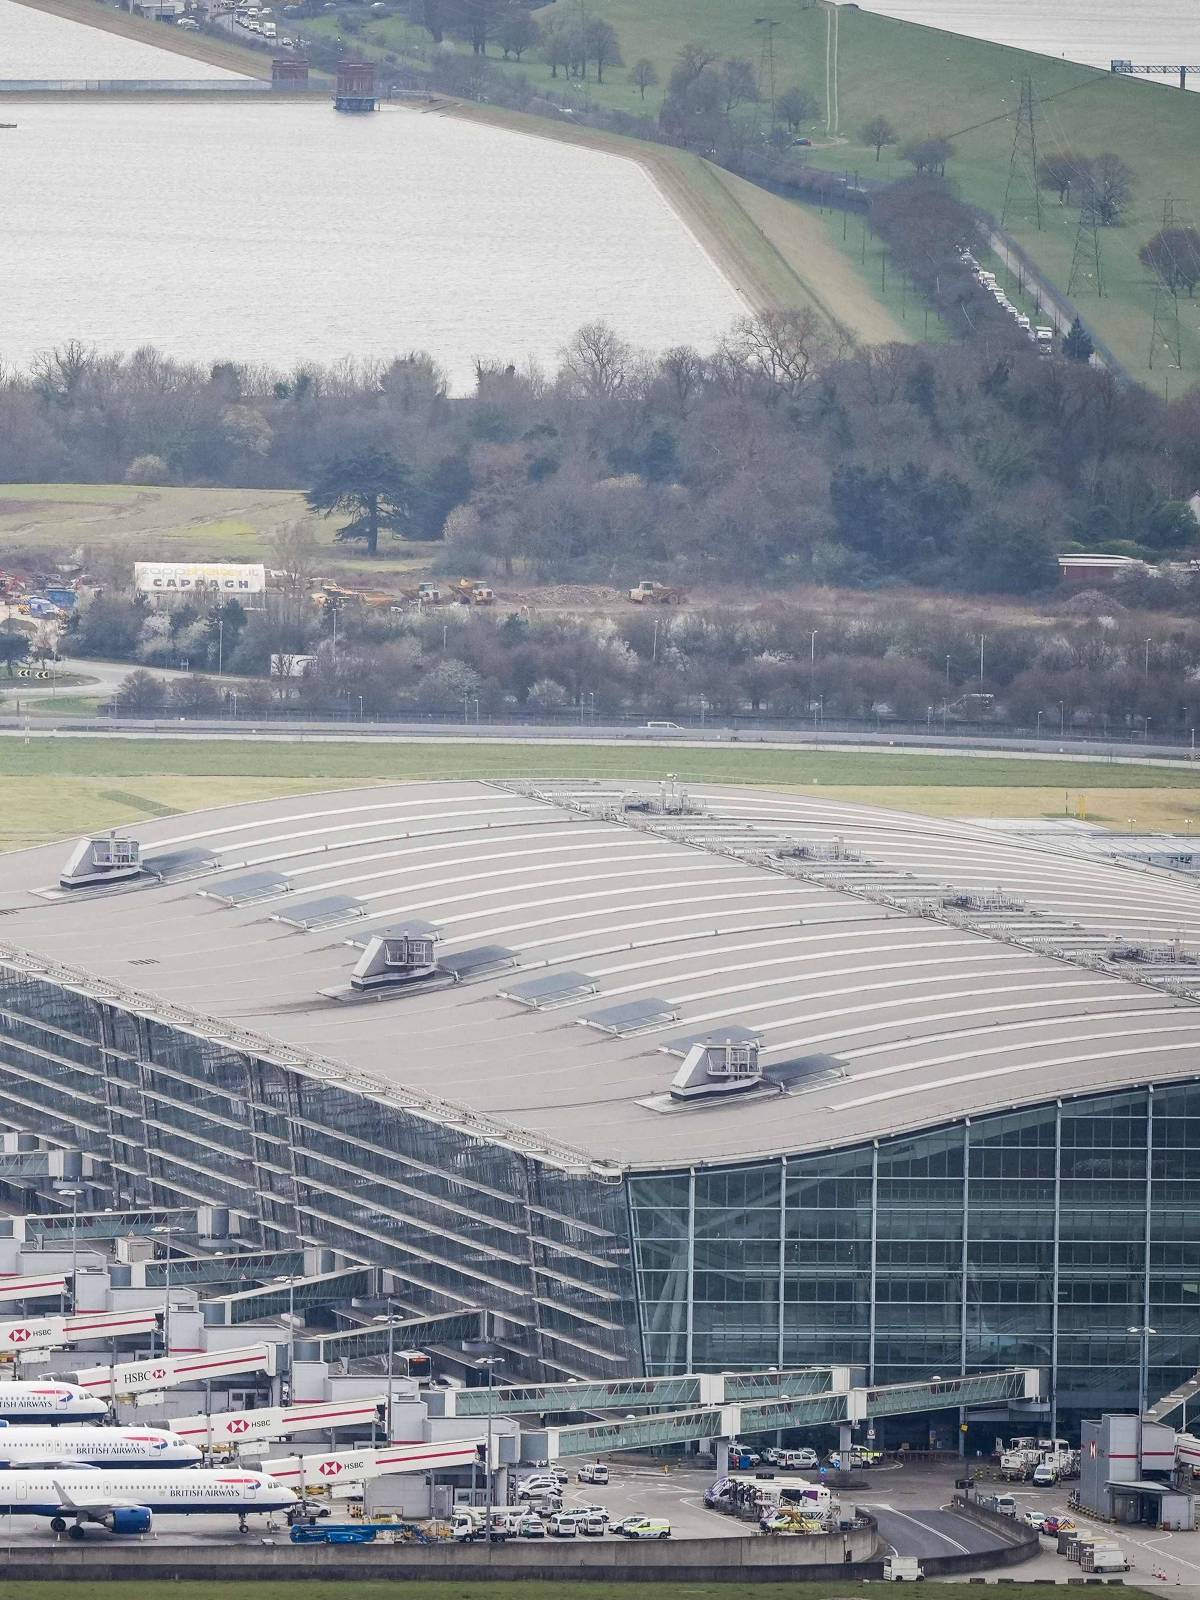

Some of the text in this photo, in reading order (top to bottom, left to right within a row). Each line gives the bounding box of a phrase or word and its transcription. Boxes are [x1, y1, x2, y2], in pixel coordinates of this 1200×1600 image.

[32, 1329, 52, 1337] HSBC
[124, 1370, 151, 1383] HSBC
[251, 1419, 271, 1428] HSBC
[344, 1461, 364, 1470] HSBC
[170, 1489, 240, 1497] BRITISH AIRWAYS
